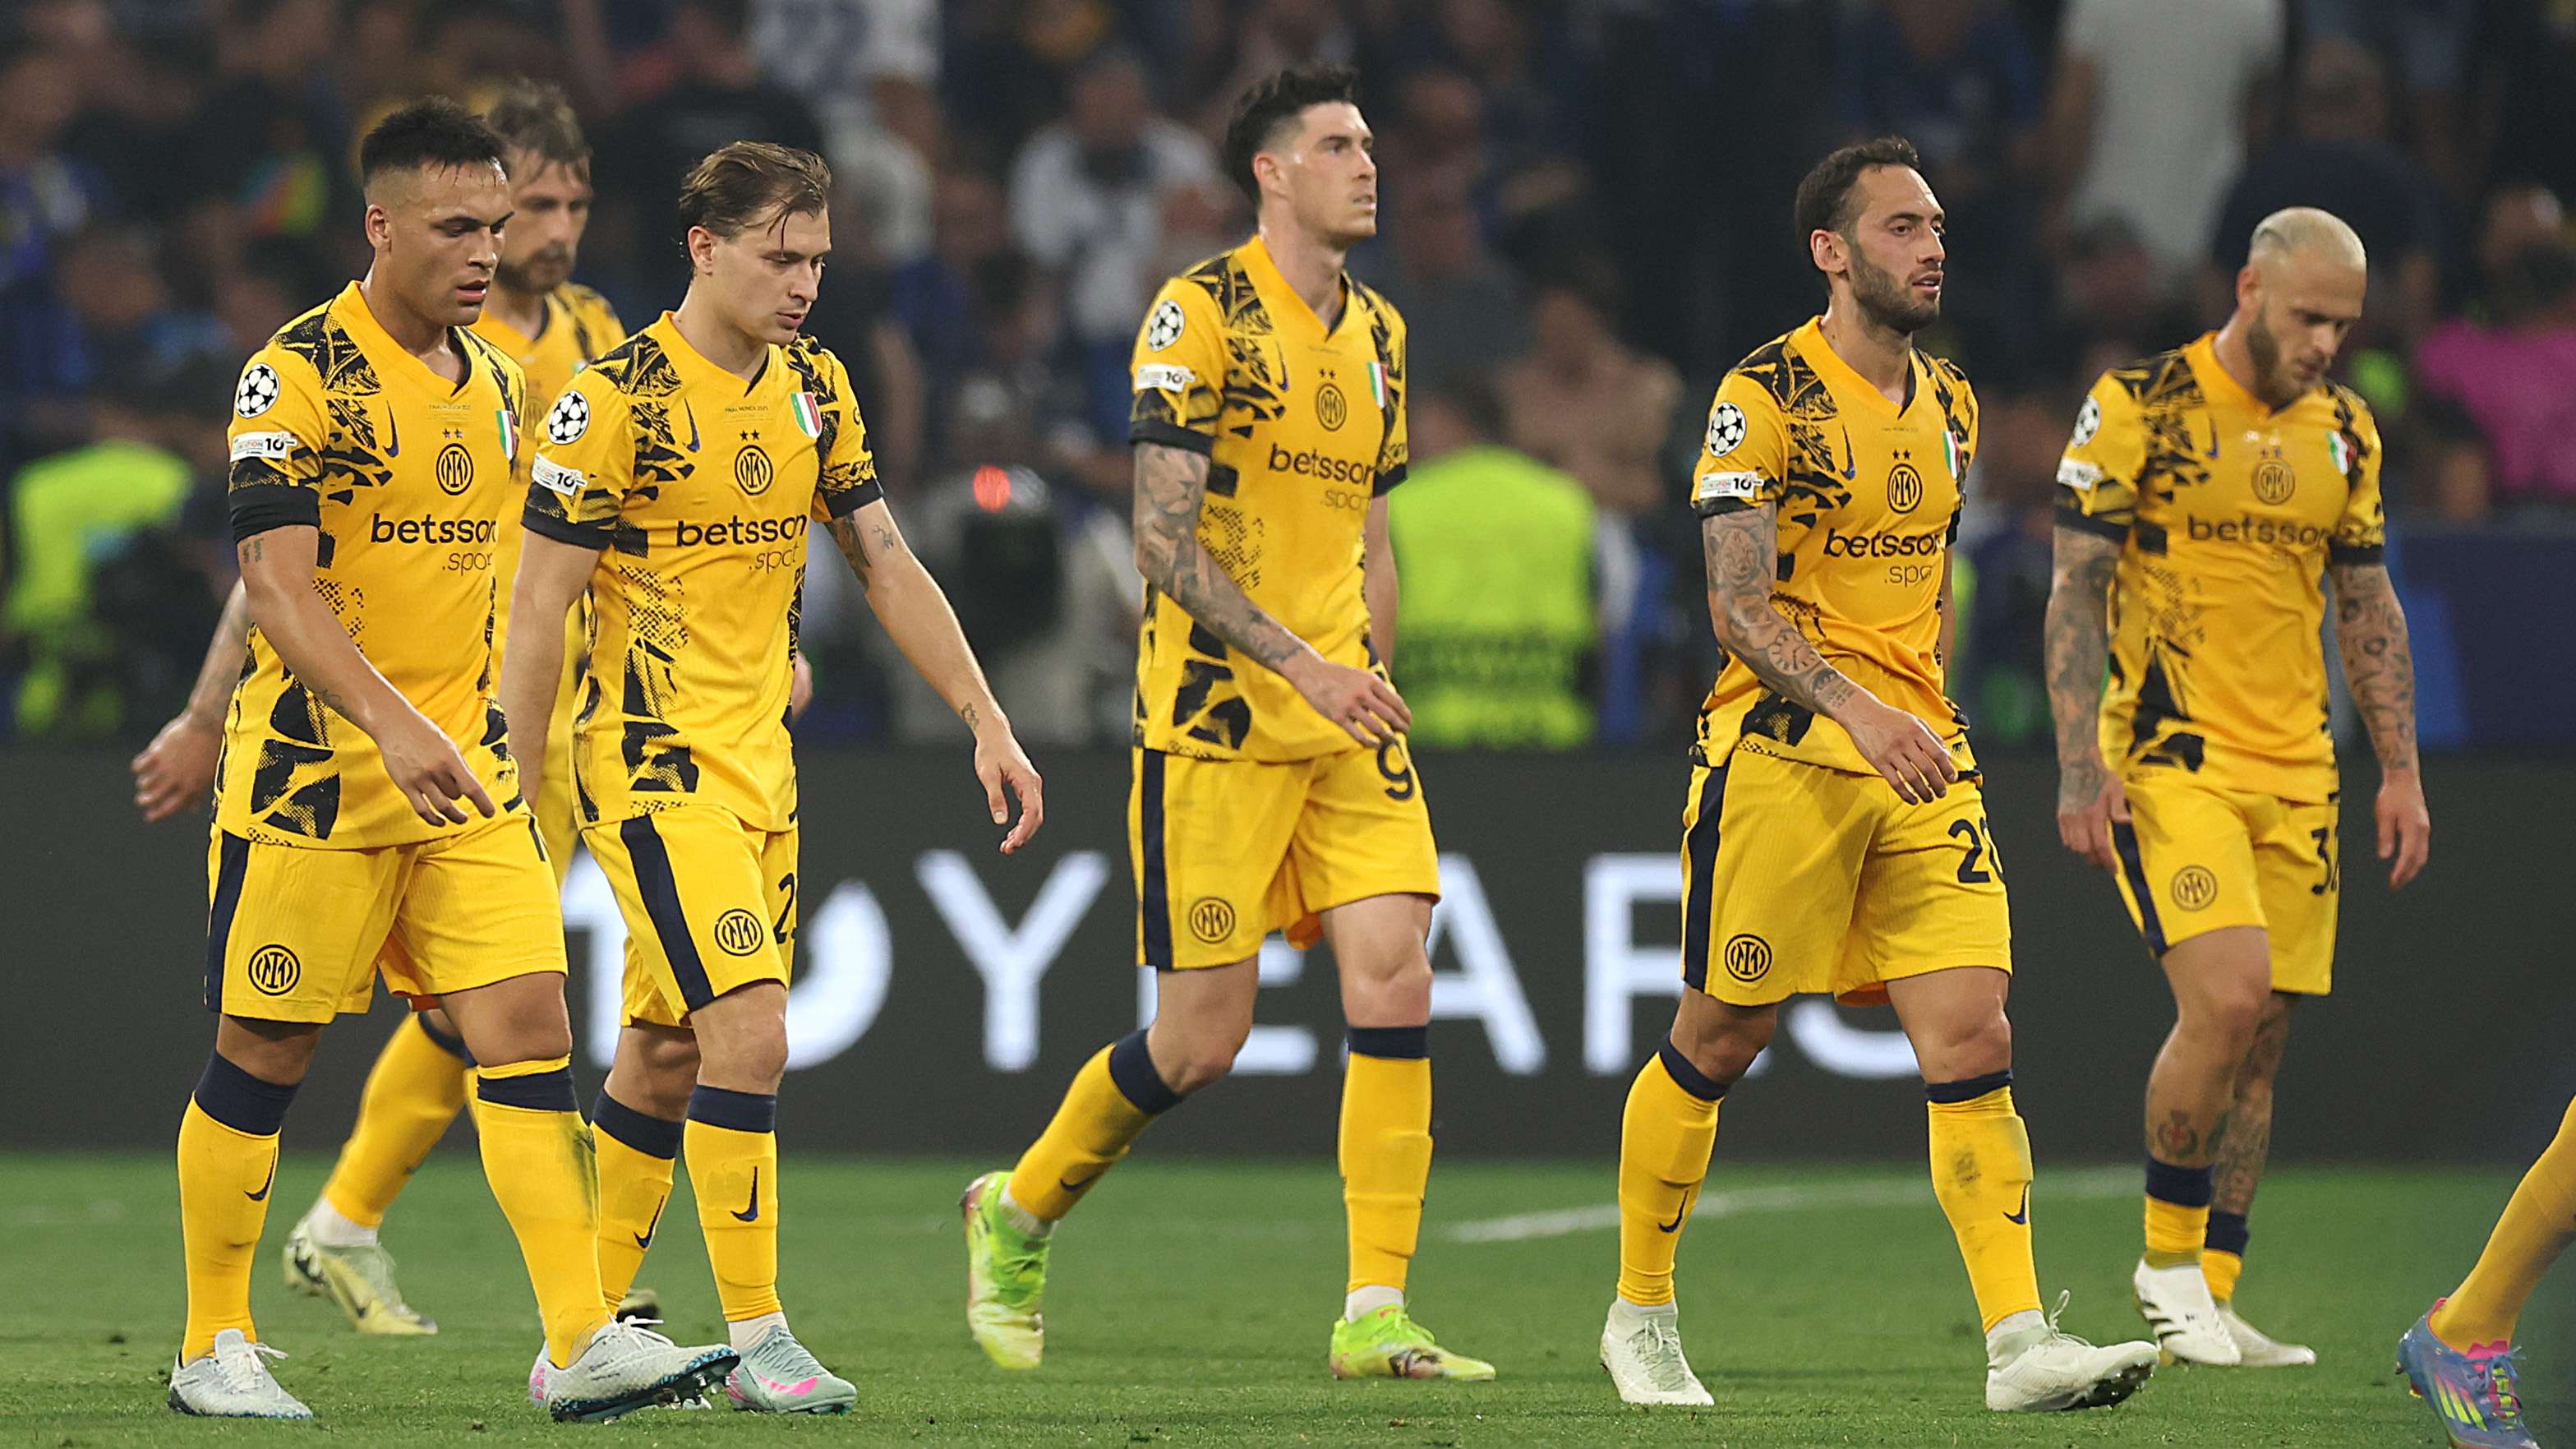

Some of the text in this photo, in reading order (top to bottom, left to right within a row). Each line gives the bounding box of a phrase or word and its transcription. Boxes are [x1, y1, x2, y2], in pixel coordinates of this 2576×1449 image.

[675, 514, 808, 547] betsson
[441, 551, 494, 576] .spor
[1376, 737, 1414, 801] 9
[2310, 827, 2340, 895] 3
[772, 872, 798, 944] 2
